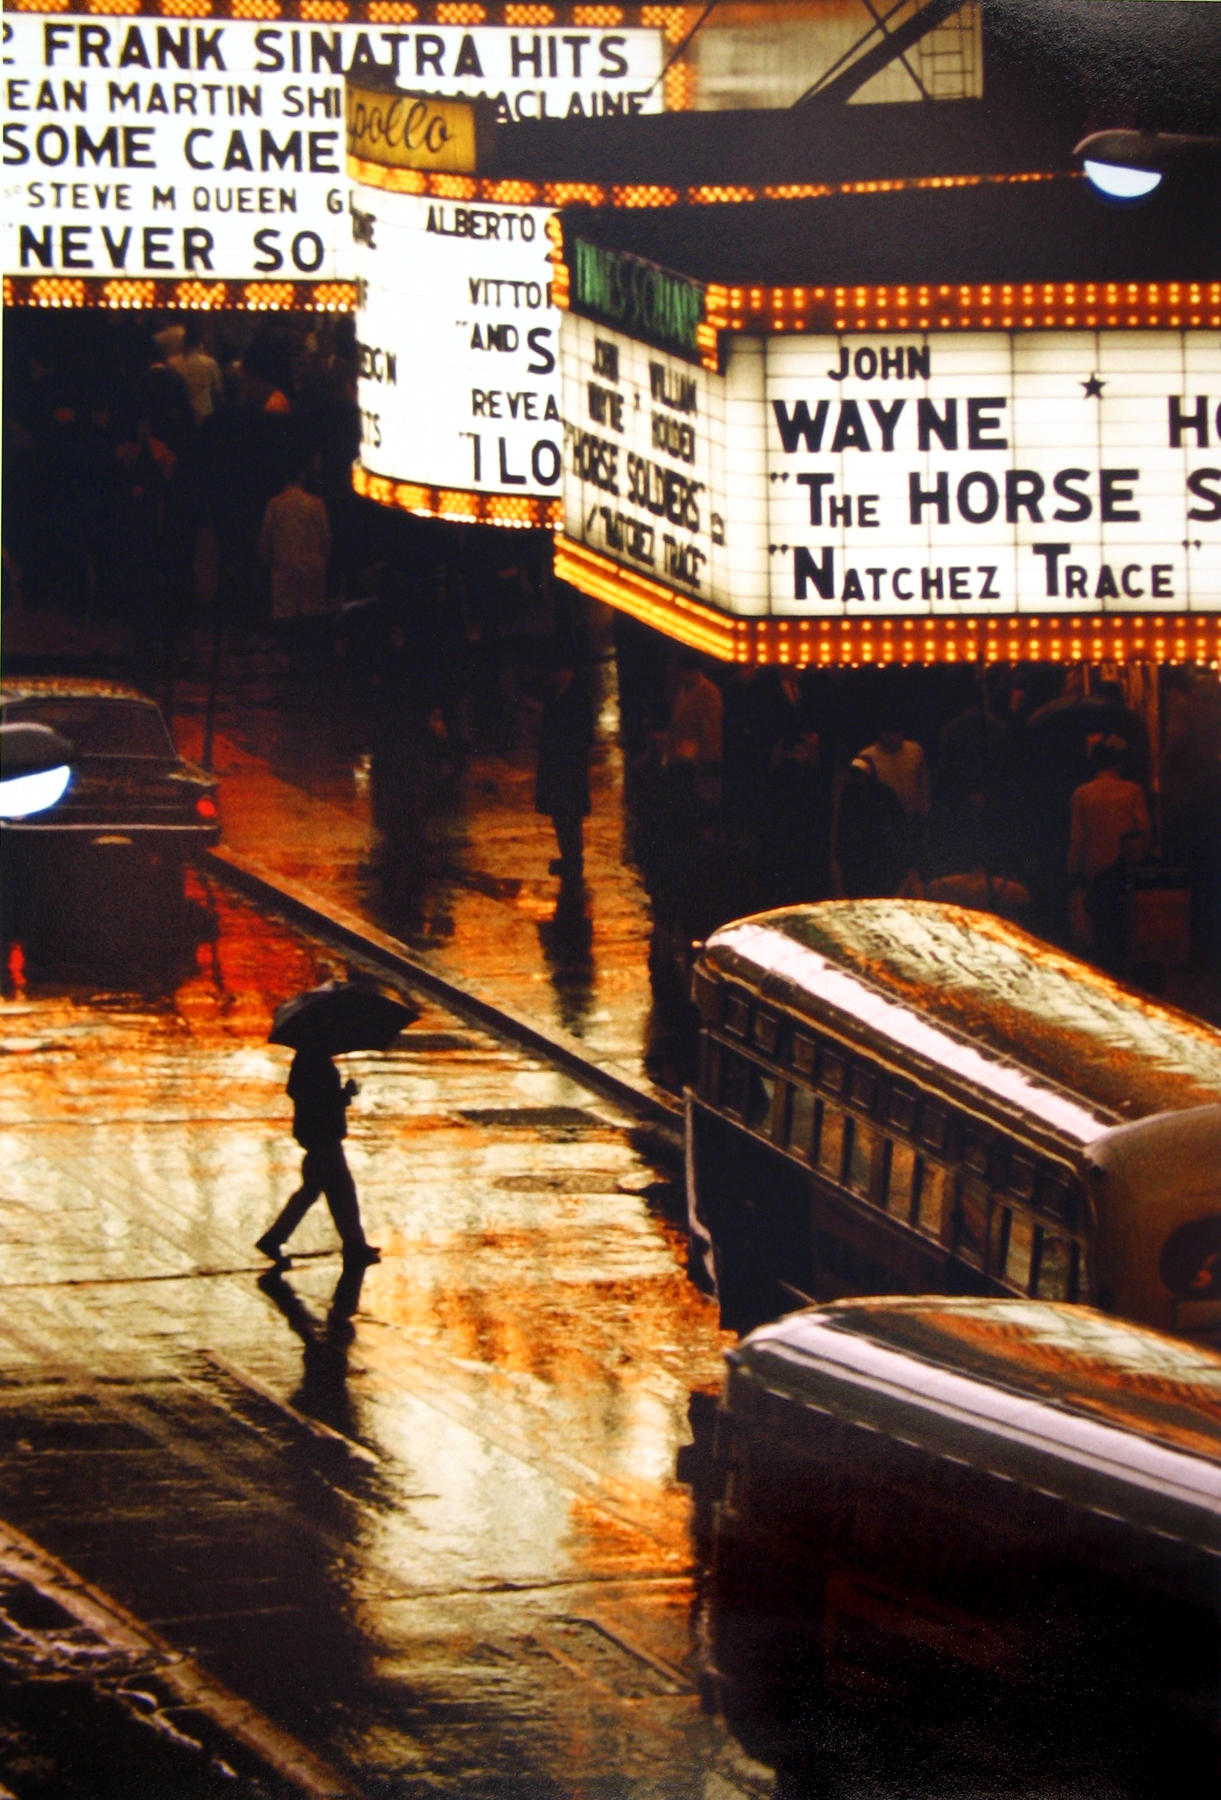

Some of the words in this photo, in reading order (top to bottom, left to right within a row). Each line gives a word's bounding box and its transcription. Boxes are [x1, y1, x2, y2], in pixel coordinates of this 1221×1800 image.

[44, 22, 227, 71] FRANK
[253, 29, 484, 77] SINATRA
[511, 35, 628, 78] HITS
[7, 79, 87, 112] EAN
[108, 81, 262, 116] MARTIN
[3, 123, 156, 168] SOME
[184, 128, 340, 173] CAME
[28, 182, 133, 210] STEVE
[193, 186, 297, 213] QUEEN
[425, 204, 535, 242] ALBERTO
[253, 228, 324, 272] SO
[827, 345, 931, 381] JOHN
[472, 388, 560, 421] REVEA
[771, 396, 1008, 453] WAYNE
[1167, 395, 1221, 449] H
[909, 468, 1141, 525] HORSE
